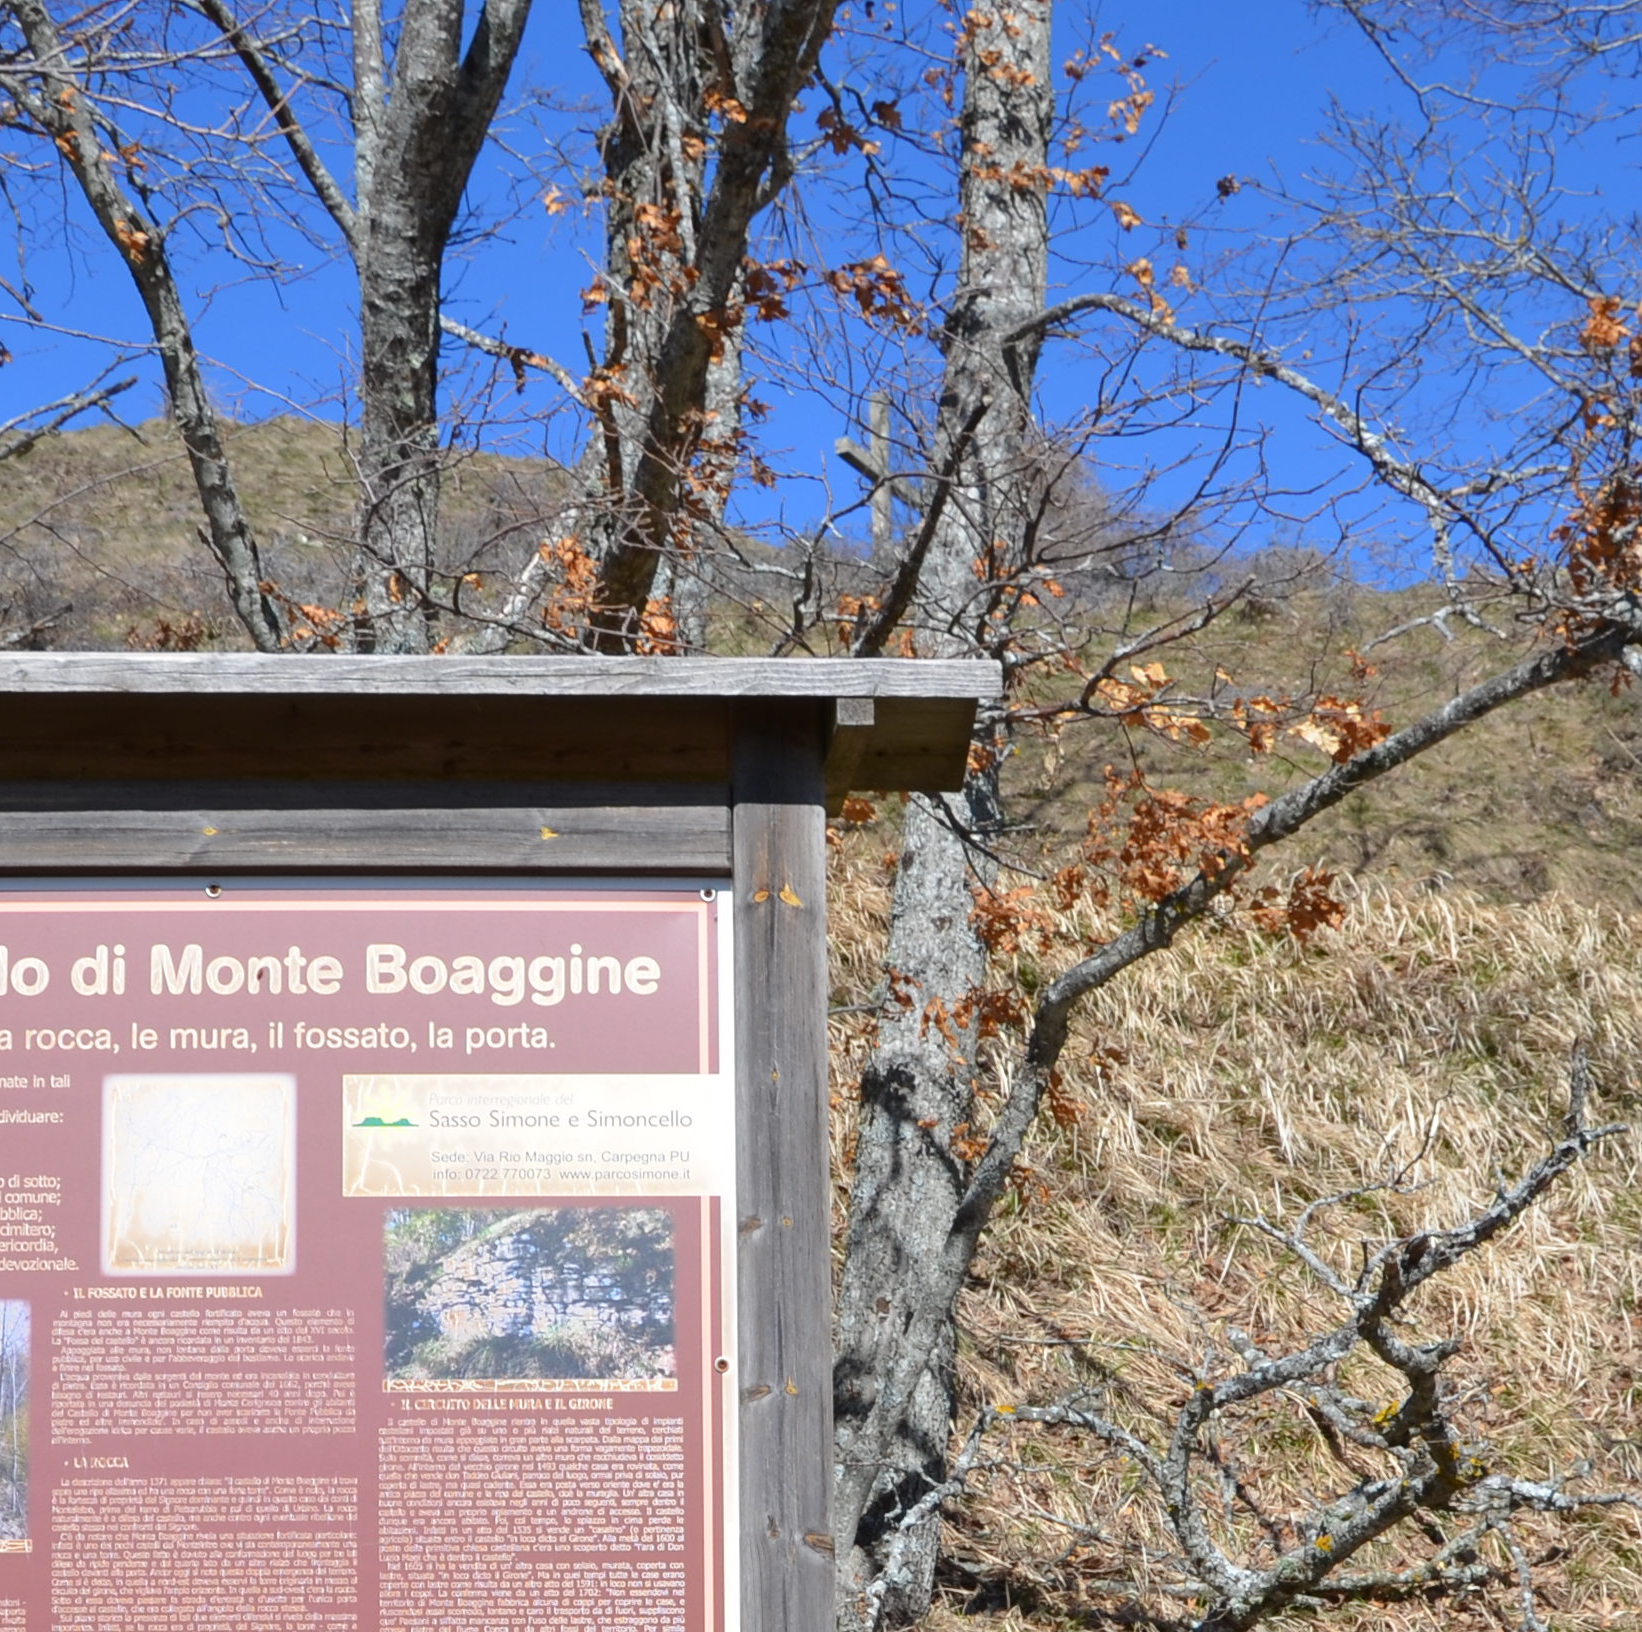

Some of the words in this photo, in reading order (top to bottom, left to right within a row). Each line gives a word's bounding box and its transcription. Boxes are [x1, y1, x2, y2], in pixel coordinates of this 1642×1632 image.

[70, 943, 125, 996] di
[150, 942, 343, 995] Monte
[365, 942, 661, 1006] Boaggine
[25, 1028, 119, 1054] rocca,
[131, 1022, 158, 1049] le
[170, 1027, 257, 1053] mura,
[269, 1021, 283, 1048] il
[293, 1021, 417, 1053] fossato,
[428, 1021, 453, 1048] la
[465, 1022, 555, 1054] porta.
[50, 1074, 70, 1088] tali
[429, 1109, 481, 1128] Sasso
[489, 1109, 560, 1127] Simone
[587, 1109, 692, 1127] Simoncello
[431, 1151, 468, 1162] Sede:
[473, 1151, 494, 1163] Via
[499, 1151, 520, 1162] Rio
[525, 1151, 573, 1165] Maggio
[601, 1150, 665, 1164] Carpegna
[670, 1150, 689, 1162] PU
[433, 1168, 460, 1180] info:
[464, 1167, 498, 1180] 0722
[503, 1167, 551, 1180] 770073
[559, 1168, 690, 1181] www.parcosimone.it
[23, 1175, 60, 1190] sotto;
[4, 1192, 61, 1206] comune;
[73, 1287, 85, 1299] IL
[87, 1287, 137, 1299] FOSSATO
[139, 1287, 147, 1298] E
[149, 1287, 164, 1298] LA
[166, 1286, 203, 1298] FONTE
[205, 1286, 262, 1298] PUBBLICA
[401, 1399, 412, 1410] IL
[414, 1398, 470, 1410] CIRCUITO
[473, 1398, 506, 1410] DELLE
[509, 1398, 542, 1410] MURA
[544, 1398, 552, 1409] E
[554, 1398, 566, 1410] IL
[568, 1398, 612, 1409] GIRONE
